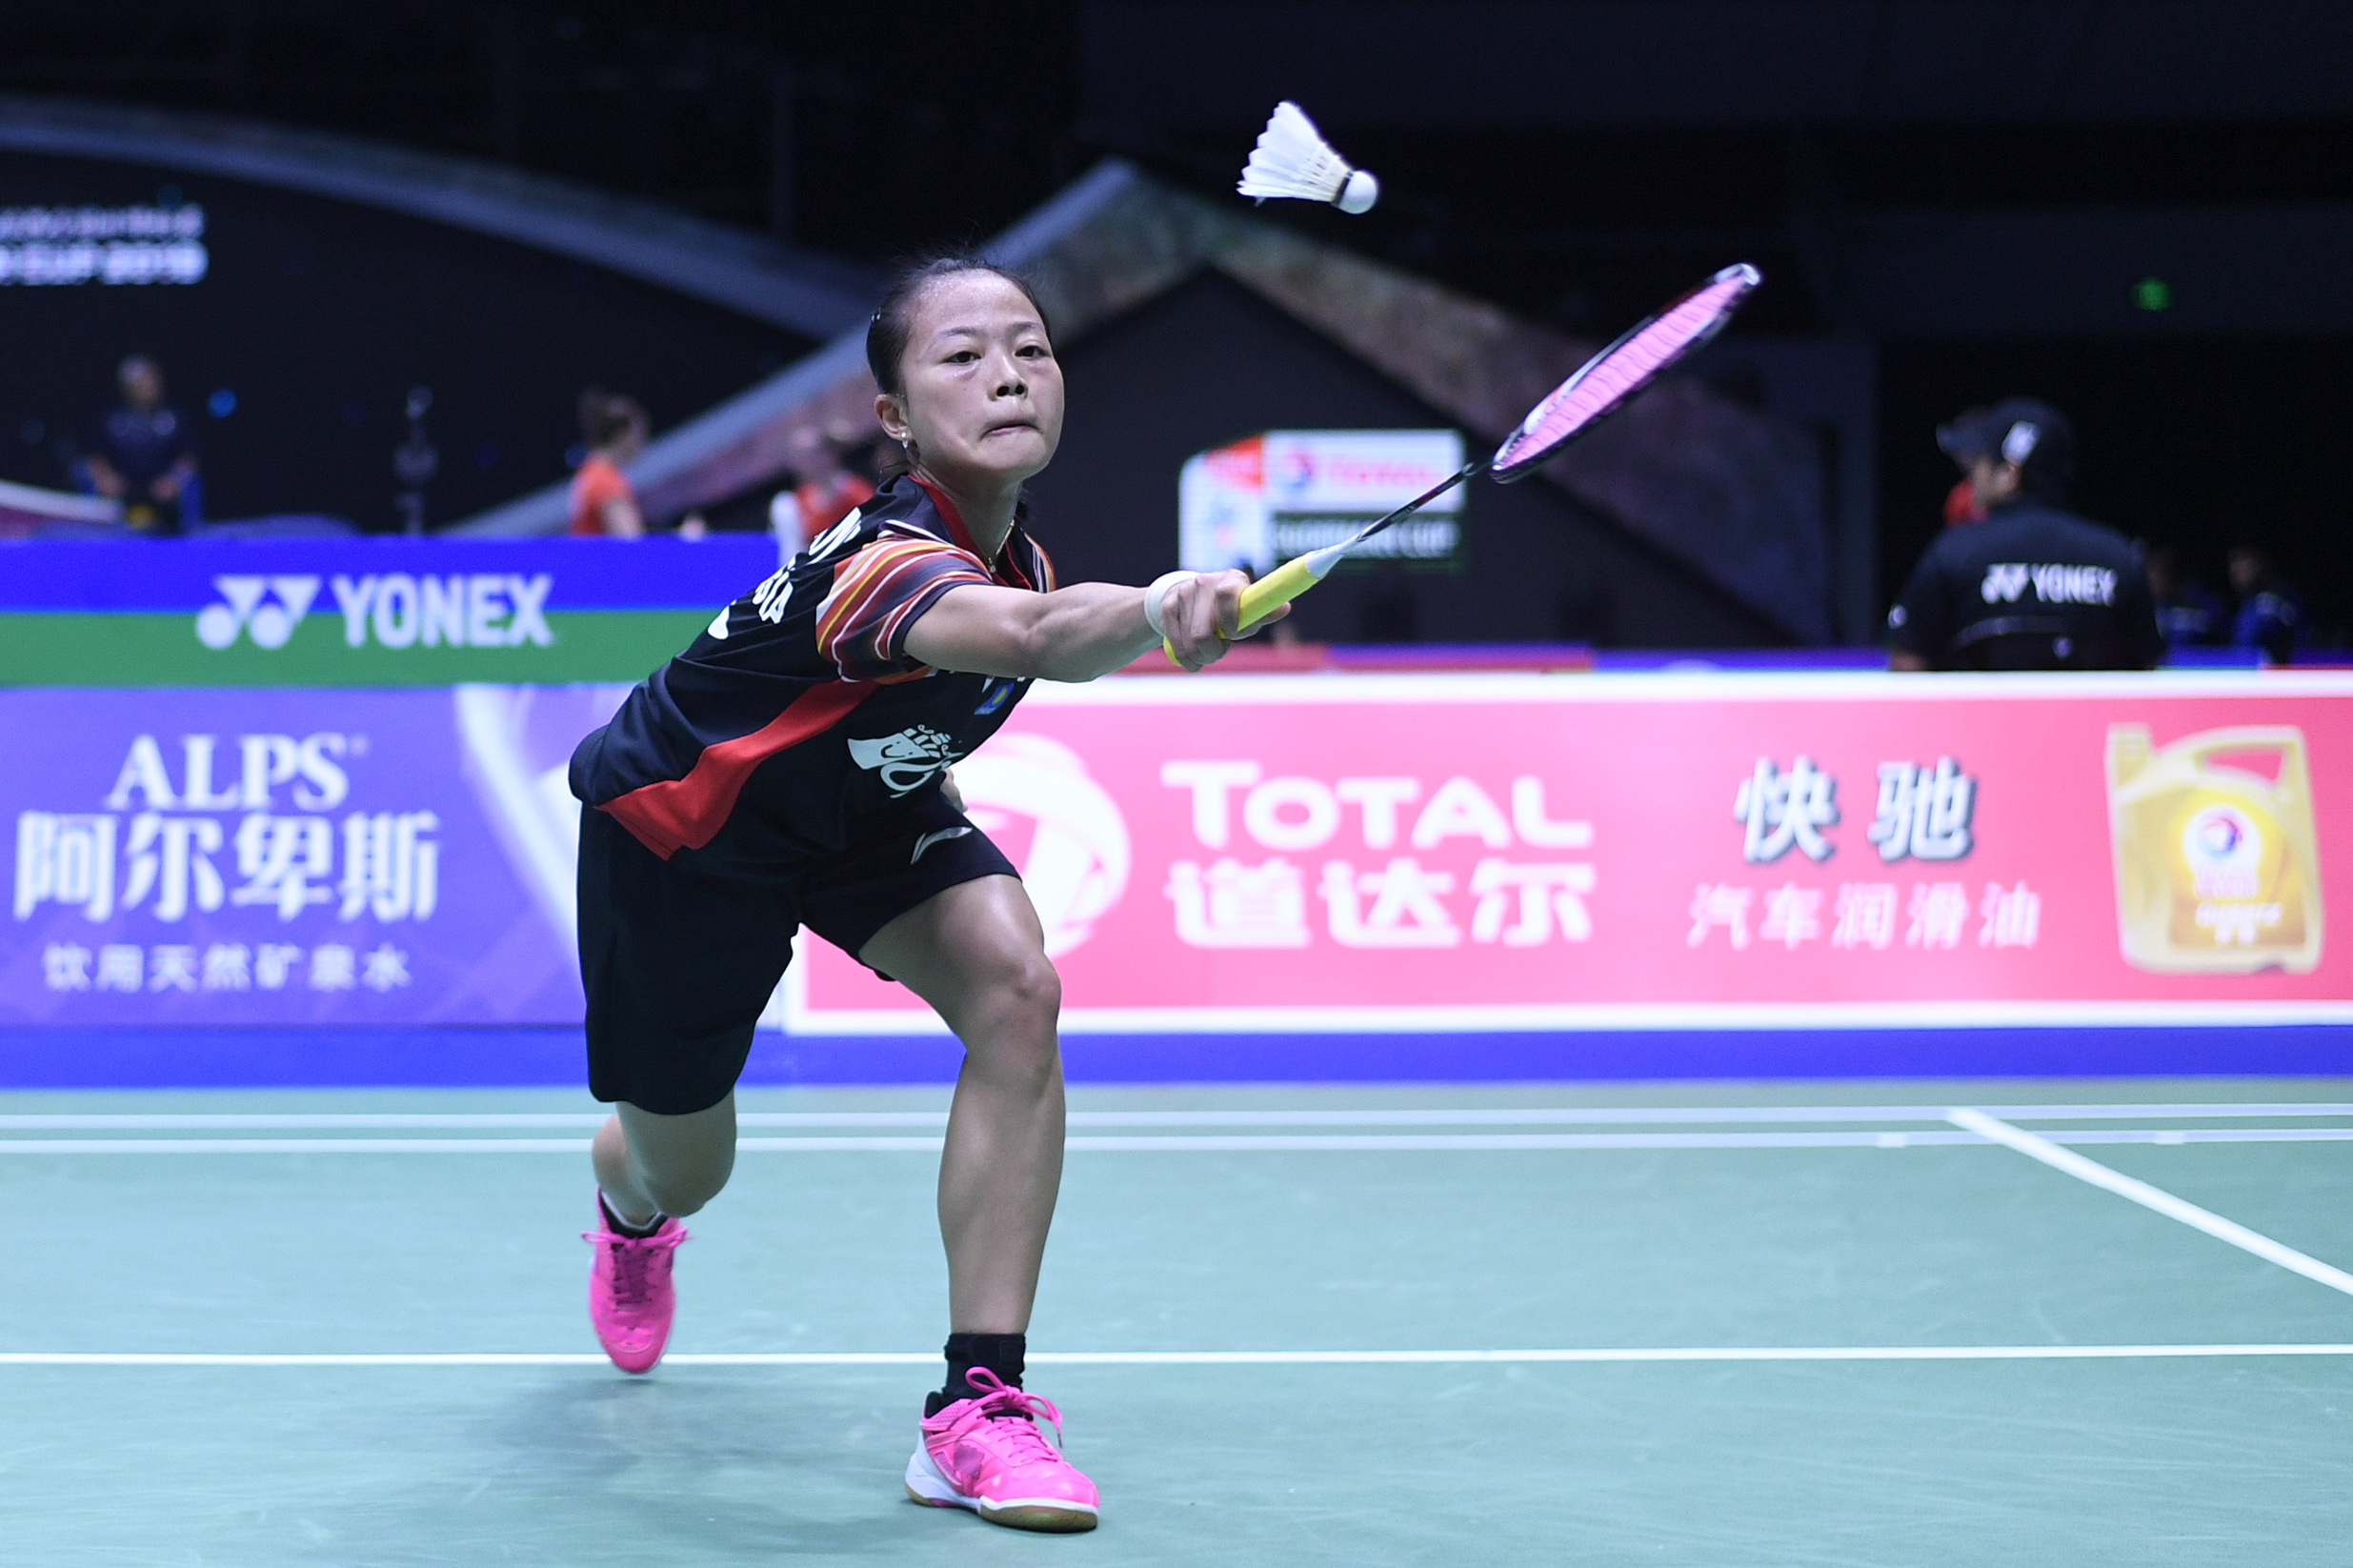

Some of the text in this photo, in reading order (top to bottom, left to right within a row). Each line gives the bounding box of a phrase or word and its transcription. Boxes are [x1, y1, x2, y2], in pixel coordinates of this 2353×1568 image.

[332, 573, 554, 647] YONEX
[2031, 563, 2117, 607] YONEX
[108, 733, 351, 811] ALPS
[1159, 760, 1595, 851] TOTAL
[1732, 754, 1980, 863] 快驰
[12, 810, 440, 922] 阿尔卑斯
[1161, 856, 1598, 949] 道达尔
[1685, 879, 2041, 951] 汽车润滑油
[43, 941, 412, 993] 饮用天然矿泉水
